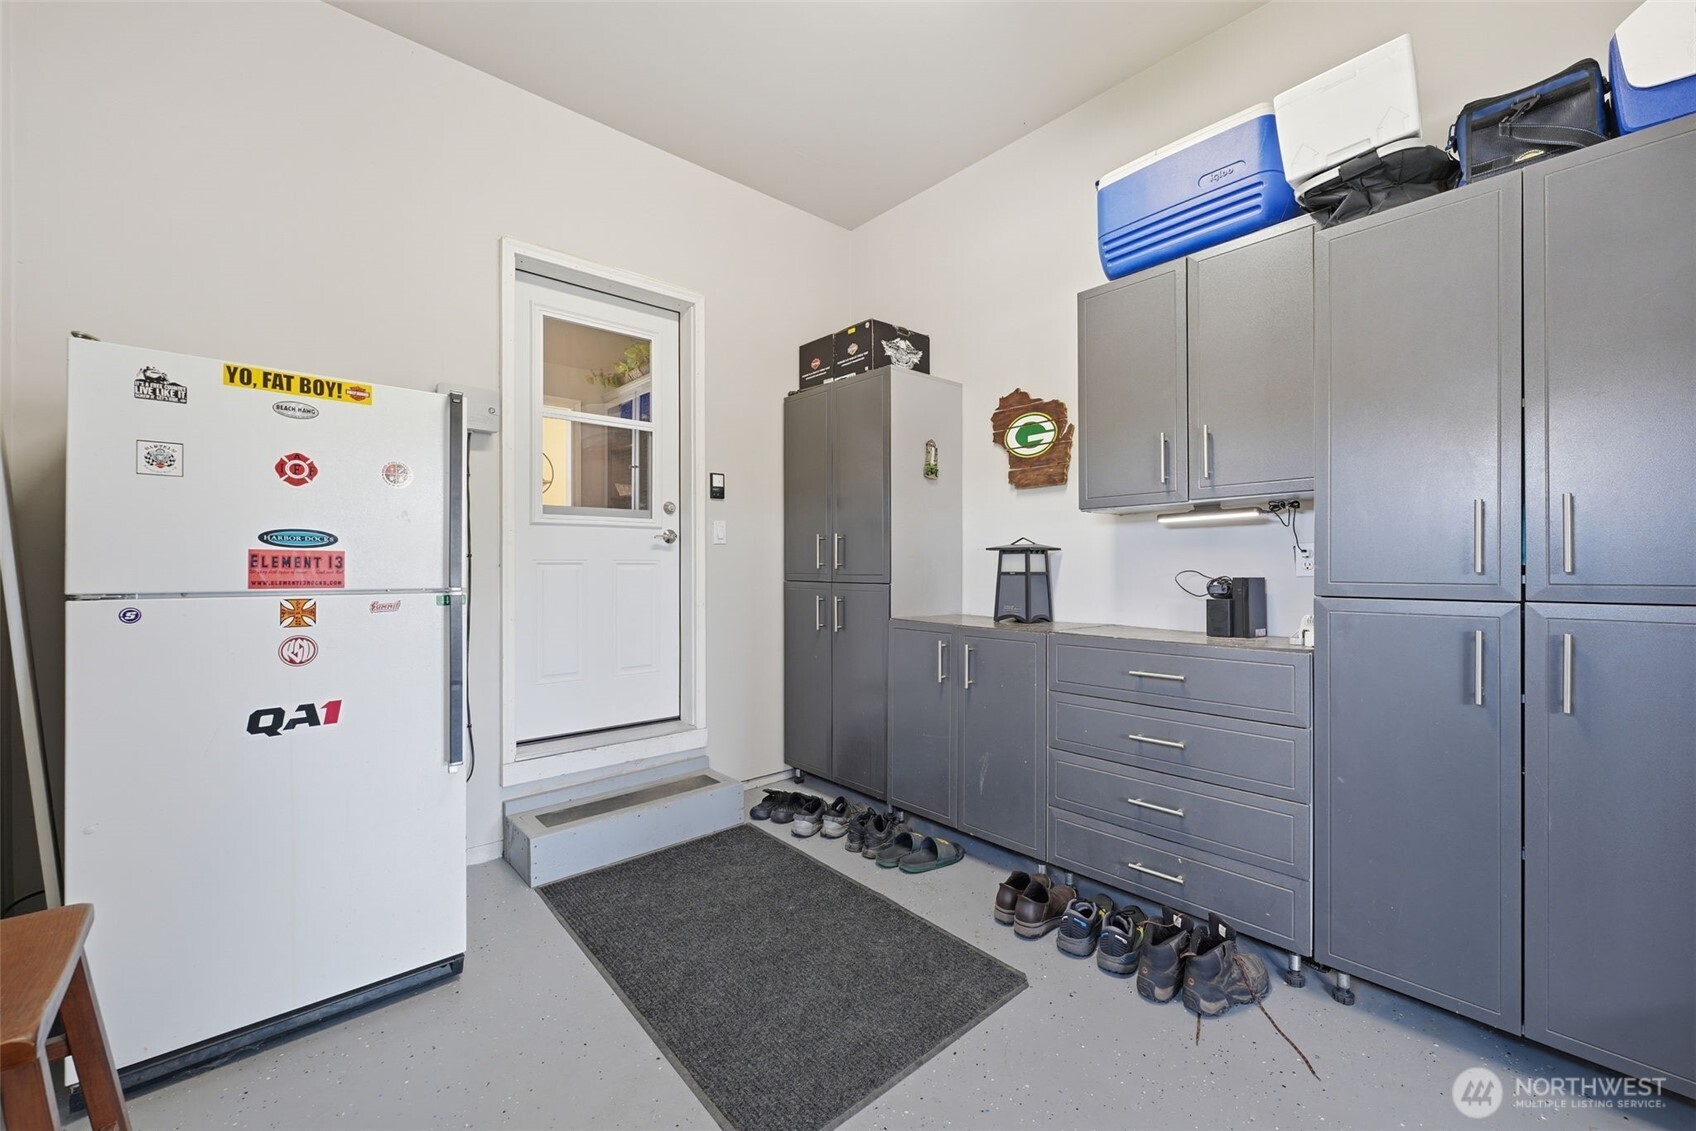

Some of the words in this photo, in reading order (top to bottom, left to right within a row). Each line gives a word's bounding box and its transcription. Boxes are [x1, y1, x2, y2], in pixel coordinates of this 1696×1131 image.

[1210, 168, 1234, 183] igloo
[226, 365, 257, 389] YO,
[262, 371, 294, 392] FAT
[299, 377, 342, 399] BOY!
[135, 386, 153, 395] LIVE
[156, 388, 176, 397] LIKE
[275, 404, 296, 413] BEACH
[1006, 414, 1055, 455] G
[250, 554, 322, 569] ELEMENT
[328, 555, 344, 569] 13
[246, 699, 342, 737] QA1
